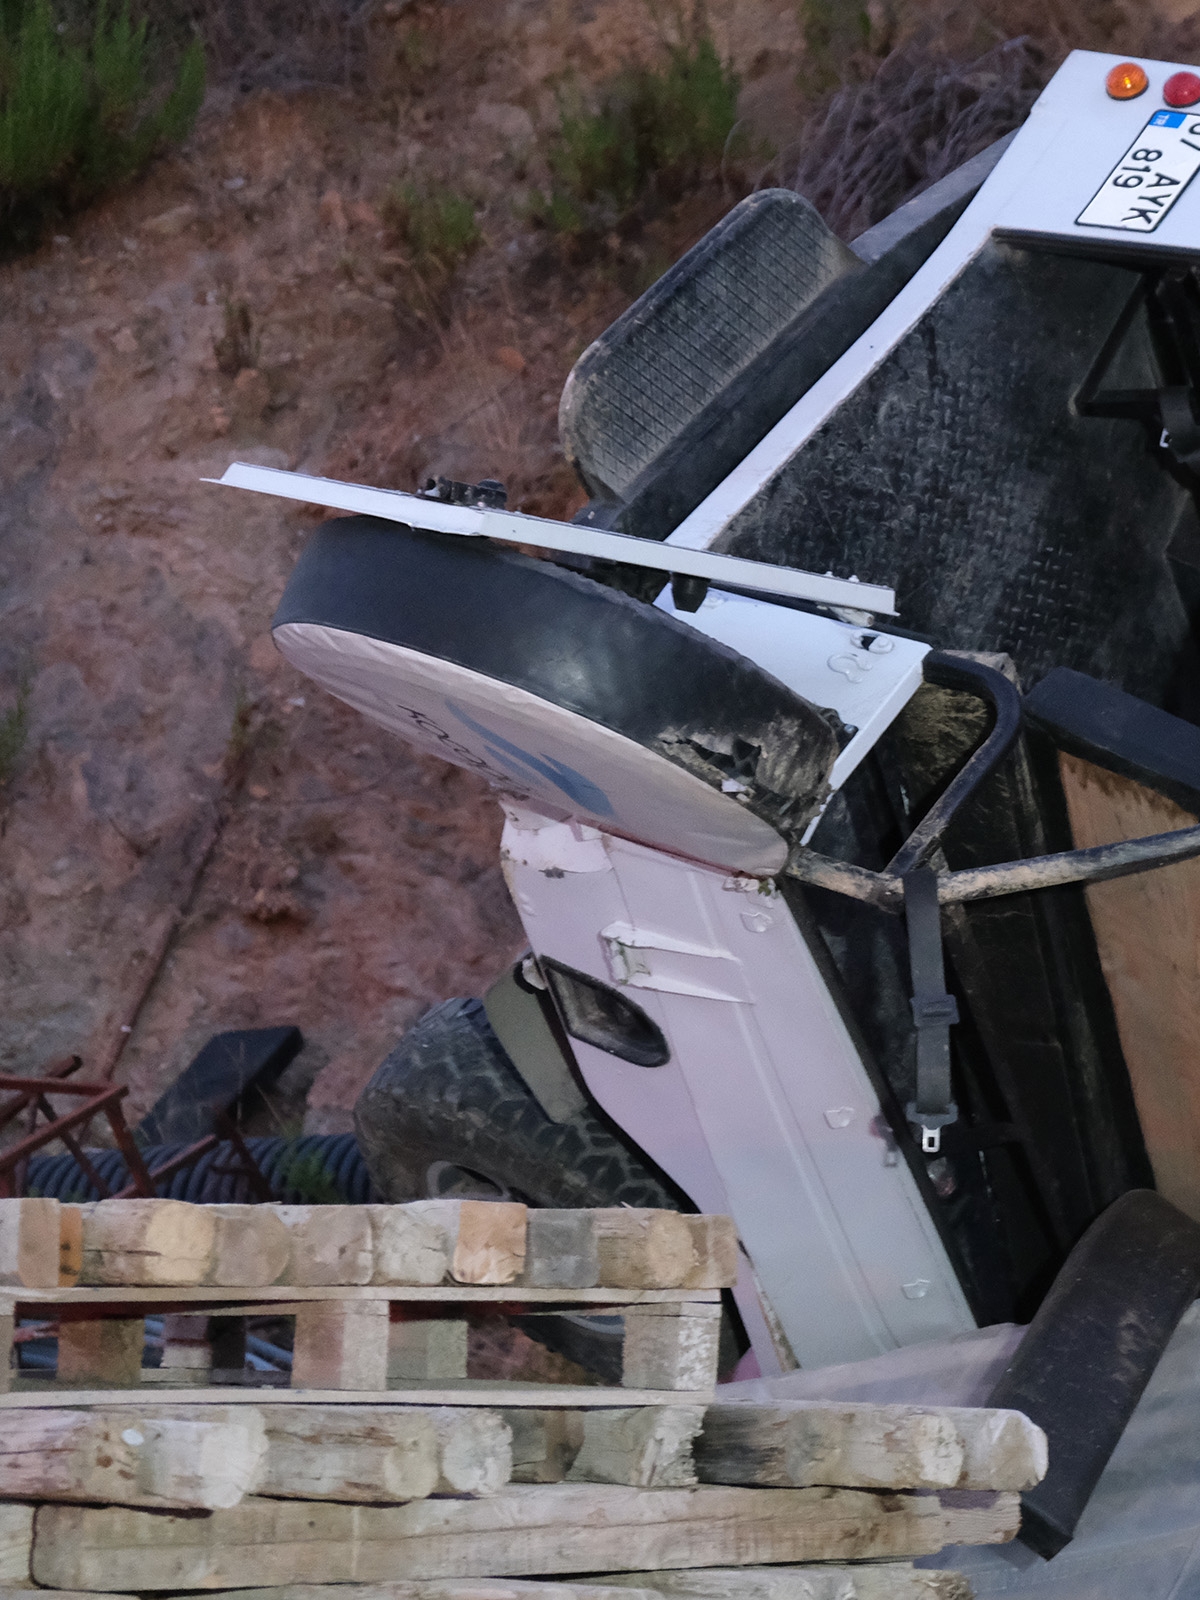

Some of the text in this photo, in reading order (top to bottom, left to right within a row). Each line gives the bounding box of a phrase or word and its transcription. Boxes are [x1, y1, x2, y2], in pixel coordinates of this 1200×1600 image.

[1153, 114, 1170, 126] TR
[1112, 148, 1163, 189] 819
[1120, 172, 1181, 225] AYK
